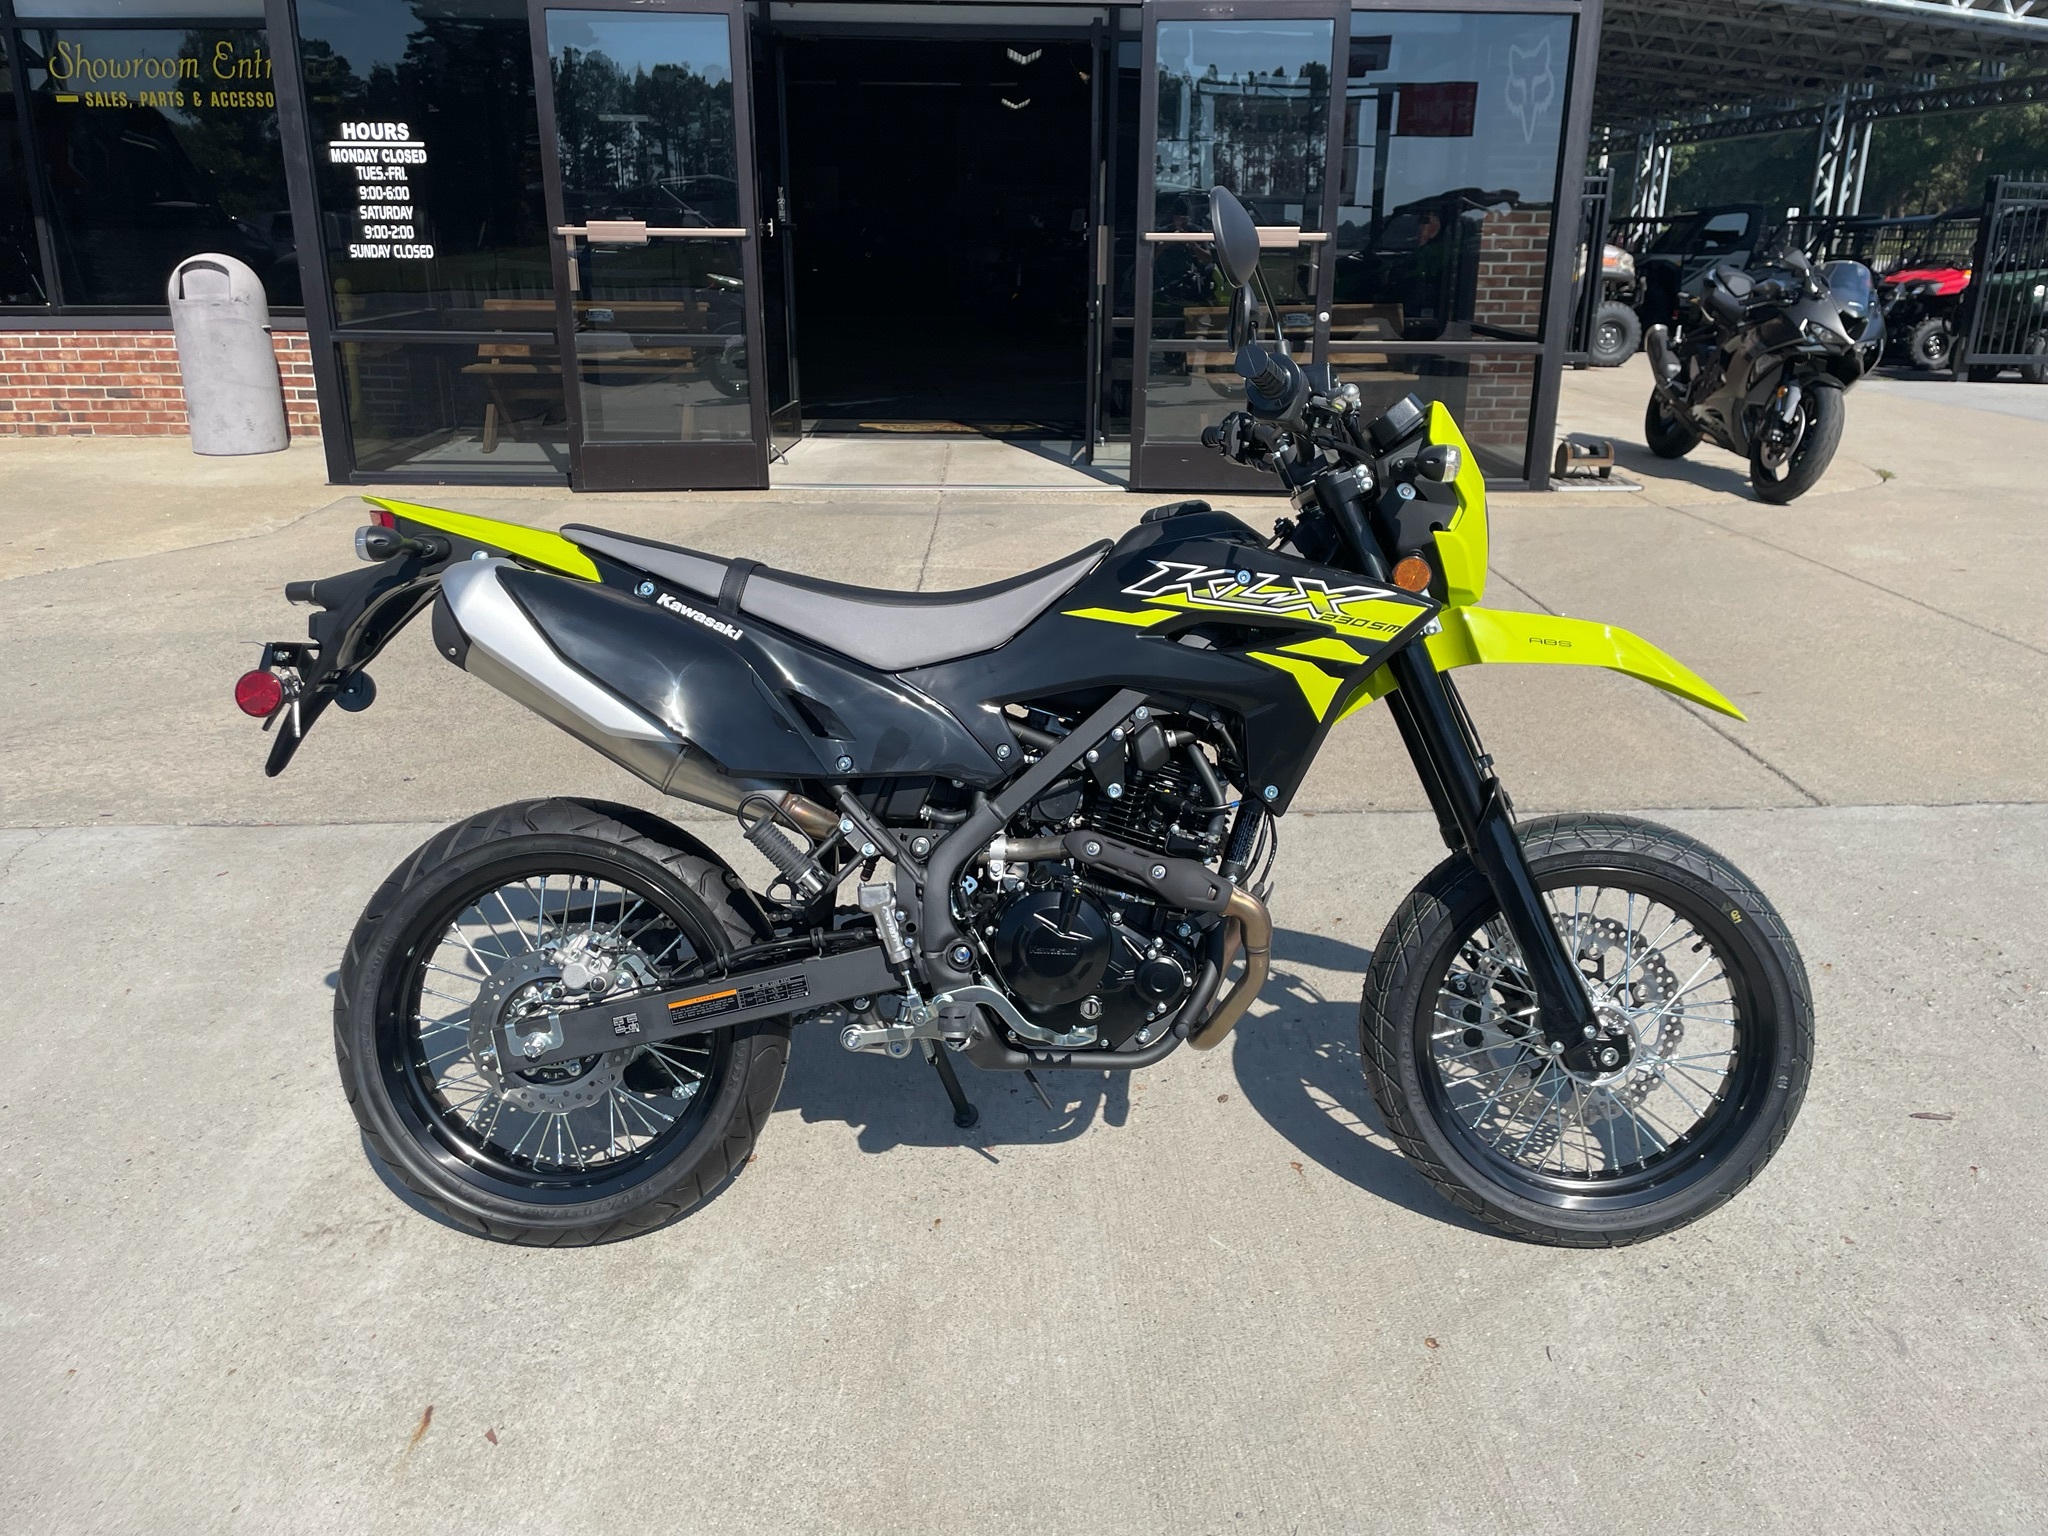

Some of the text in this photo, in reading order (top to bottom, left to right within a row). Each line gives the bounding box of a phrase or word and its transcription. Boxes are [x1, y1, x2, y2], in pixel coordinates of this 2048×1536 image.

[49, 40, 199, 83] Showroom
[85, 91, 275, 109] SALES, PARTS & ACCESSO
[341, 122, 410, 140] HOURS
[330, 148, 427, 163] MONDAY CLOSED
[356, 166, 408, 180] TUES.-FRI.
[359, 186, 410, 200] 9:00-6:00
[360, 205, 413, 219] SATURDAY
[364, 225, 414, 239] 9:00-2:00
[349, 244, 434, 259] SUNDAY CLOSED
[1121, 560, 1397, 619] KLX
[656, 593, 743, 641] Kawasaki
[1529, 637, 1572, 648] ABS
